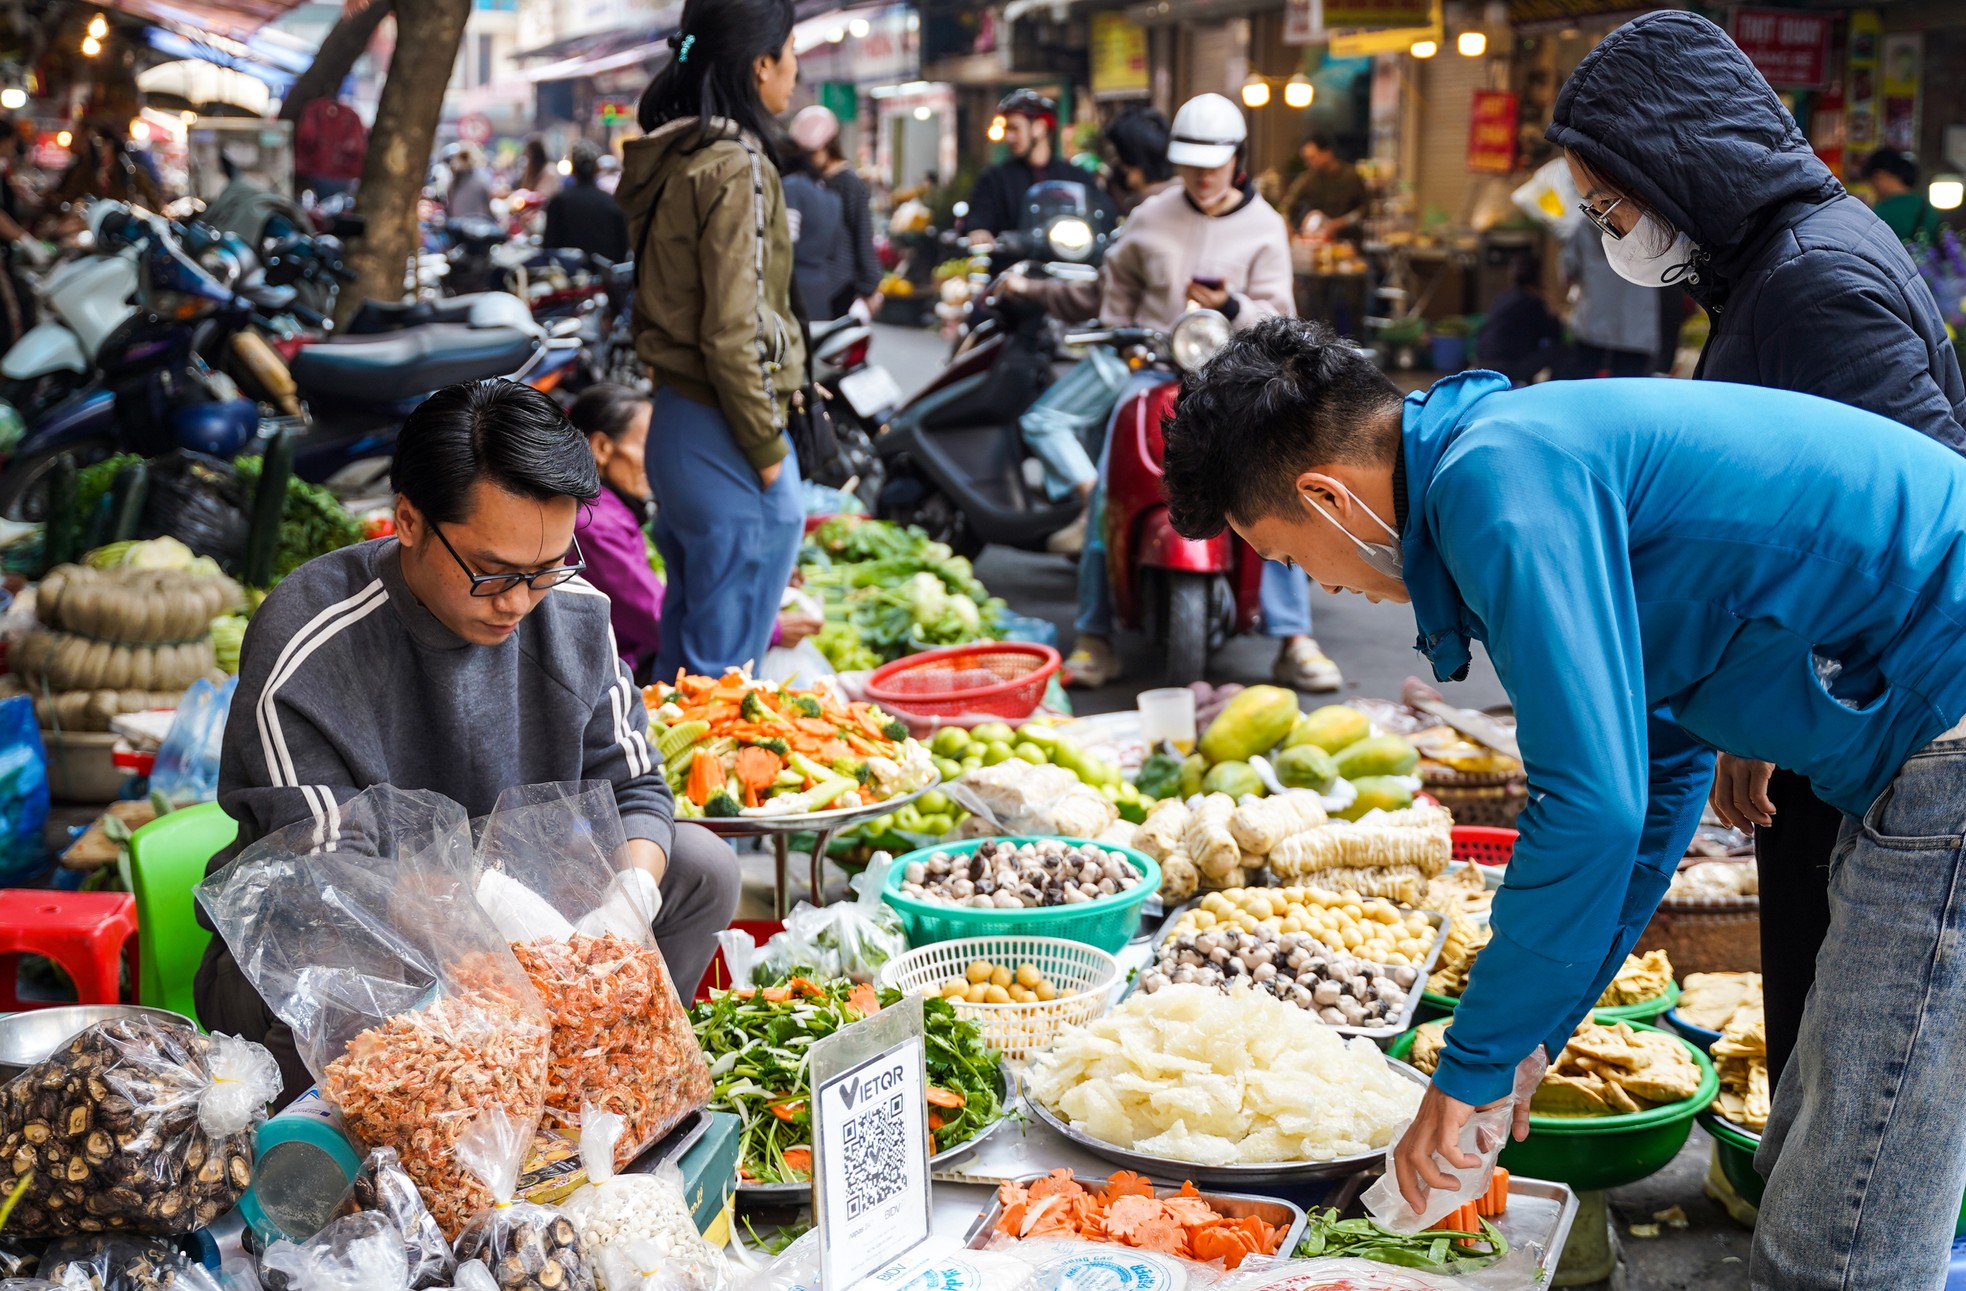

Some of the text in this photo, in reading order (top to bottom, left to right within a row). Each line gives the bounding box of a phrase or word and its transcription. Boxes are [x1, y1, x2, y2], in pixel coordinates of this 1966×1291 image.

[839, 1065, 904, 1110] VIETQR
[885, 1203, 901, 1220] BIDV
[876, 1263, 907, 1282] BIDV
